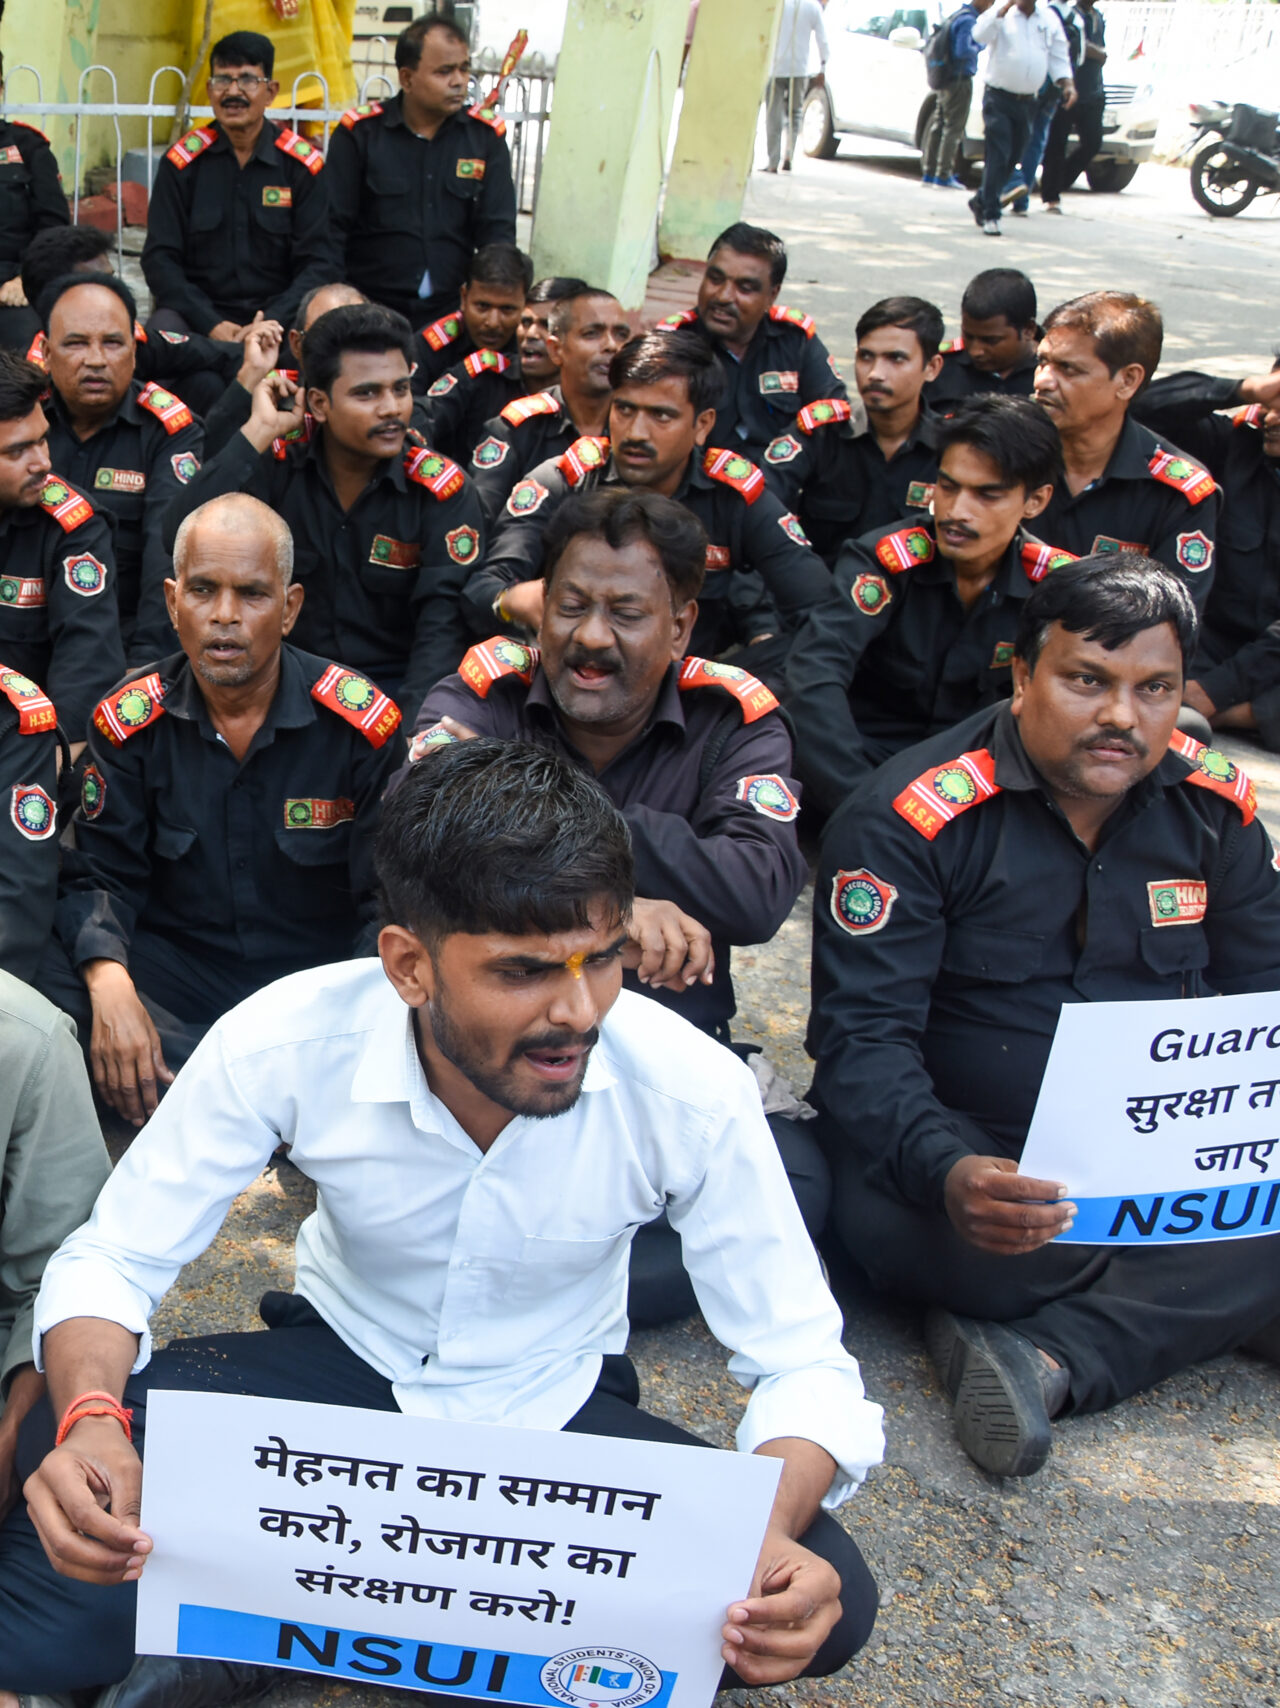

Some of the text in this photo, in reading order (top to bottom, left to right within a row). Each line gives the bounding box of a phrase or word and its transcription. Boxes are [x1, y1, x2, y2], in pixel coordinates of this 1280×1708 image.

[114, 472, 143, 487] HIND
[65, 506, 89, 526] H.S.F.
[463, 659, 485, 689] H.S.F.
[29, 711, 53, 728] H.S.F.
[375, 706, 400, 737] H.S.F.
[902, 798, 936, 833] H.S.F.
[844, 880, 877, 896] SECURITY
[869, 895, 882, 921] FORCE
[1125, 1084, 1240, 1134] सुरक्षा
[1194, 1138, 1279, 1174] जाए
[1107, 1183, 1280, 1237] NSUI
[253, 1435, 662, 1521] मेहनत का सम्मान
[258, 1504, 637, 1579] करो, रोजगार का
[293, 1562, 576, 1626] संरक्षण करो!
[275, 1622, 510, 1693] NSUI
[629, 1657, 657, 1682] UNION
[545, 1668, 578, 1704] NATIONAL
[611, 1692, 646, 1708] INDIA
[643, 1682, 656, 1695] OF
